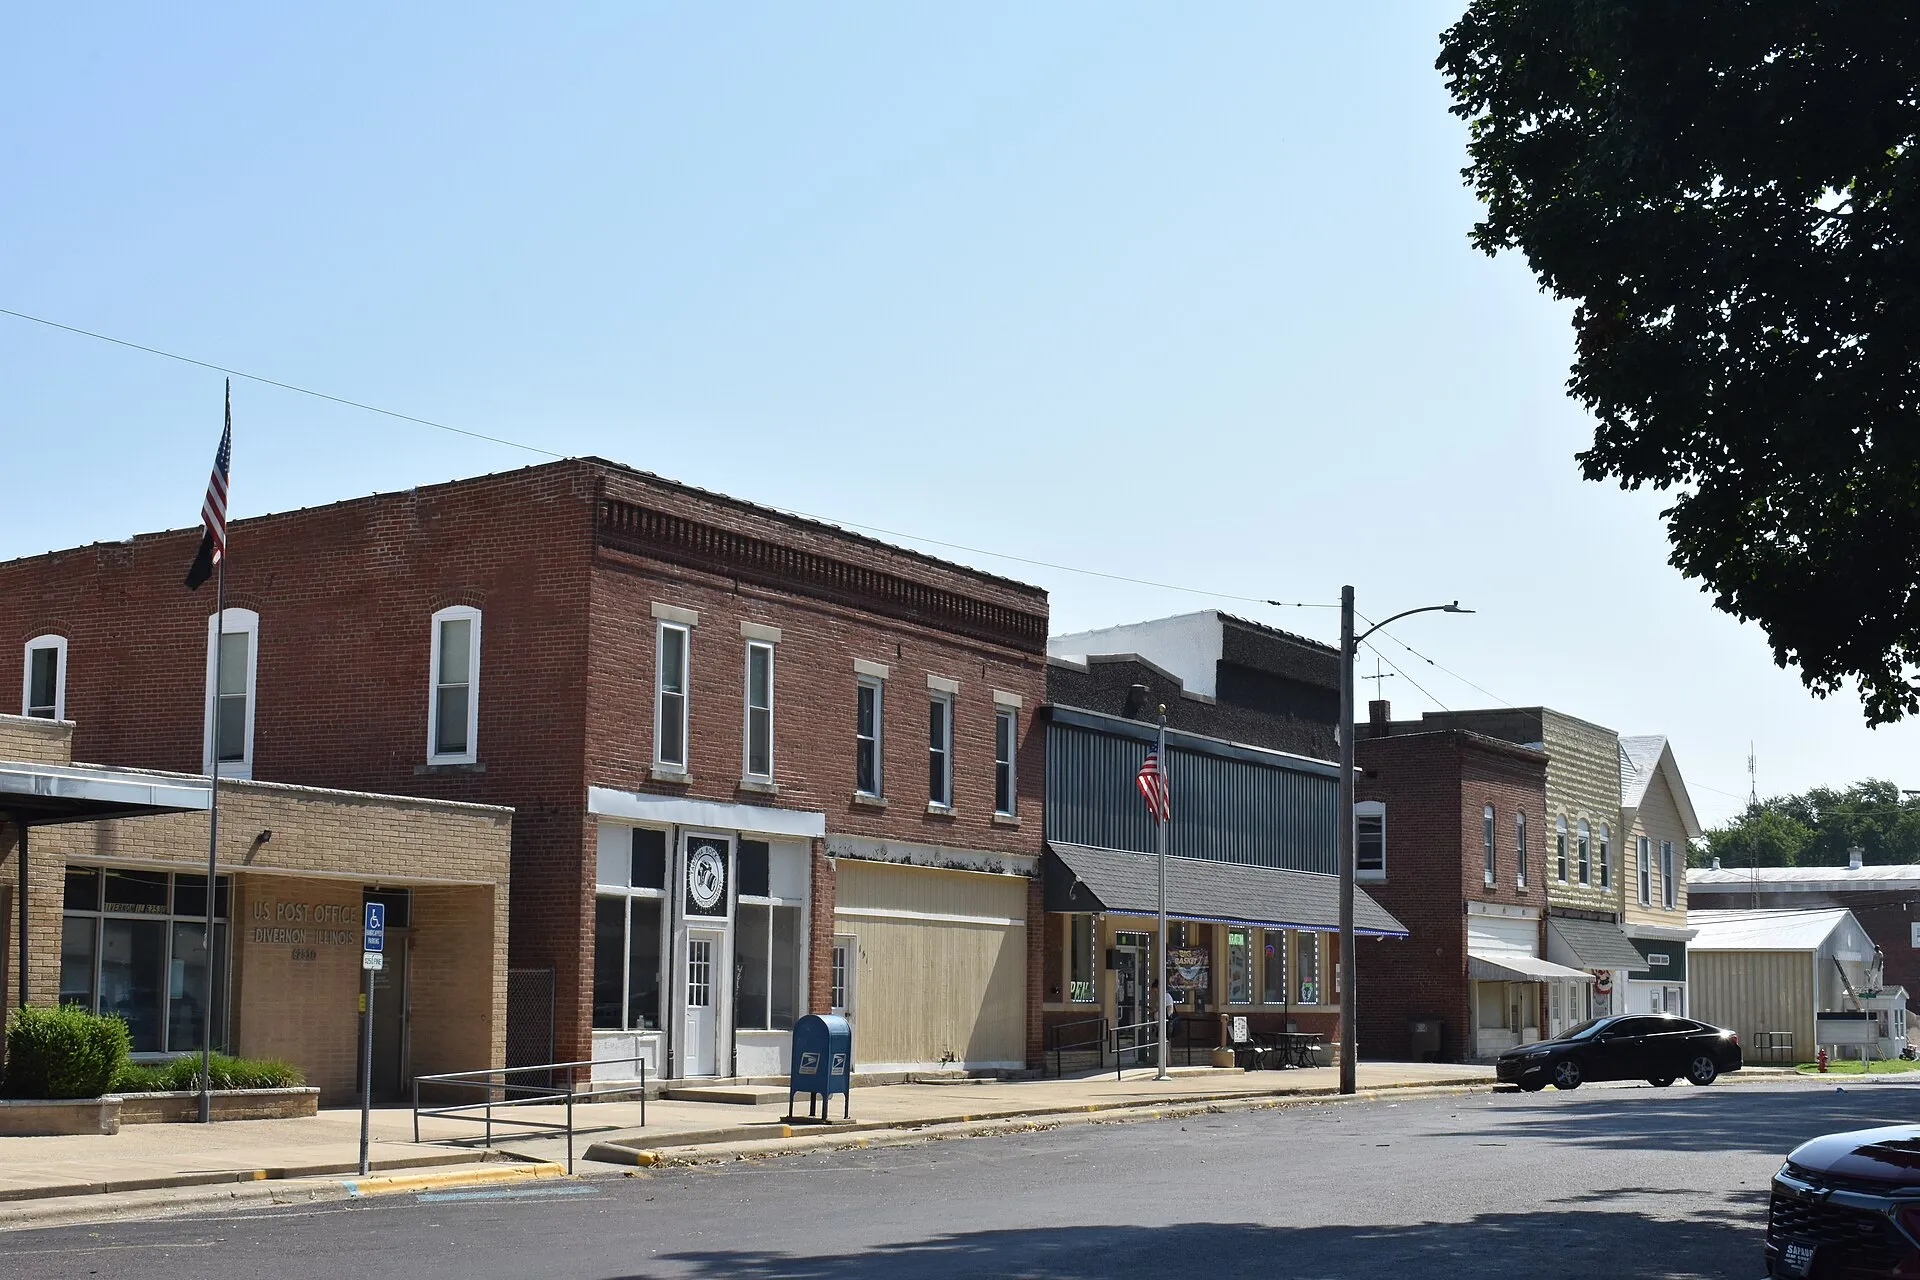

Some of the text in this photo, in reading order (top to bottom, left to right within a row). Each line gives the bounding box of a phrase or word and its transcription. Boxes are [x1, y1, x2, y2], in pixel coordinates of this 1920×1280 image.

[253, 901, 357, 924] U.S. POST OFFICE
[255, 927, 353, 945] DIVERNON ILLINOIS
[1174, 957, 1198, 965] BASKET
[1178, 949, 1192, 958] BIG
[1070, 981, 1089, 1000] PEN
